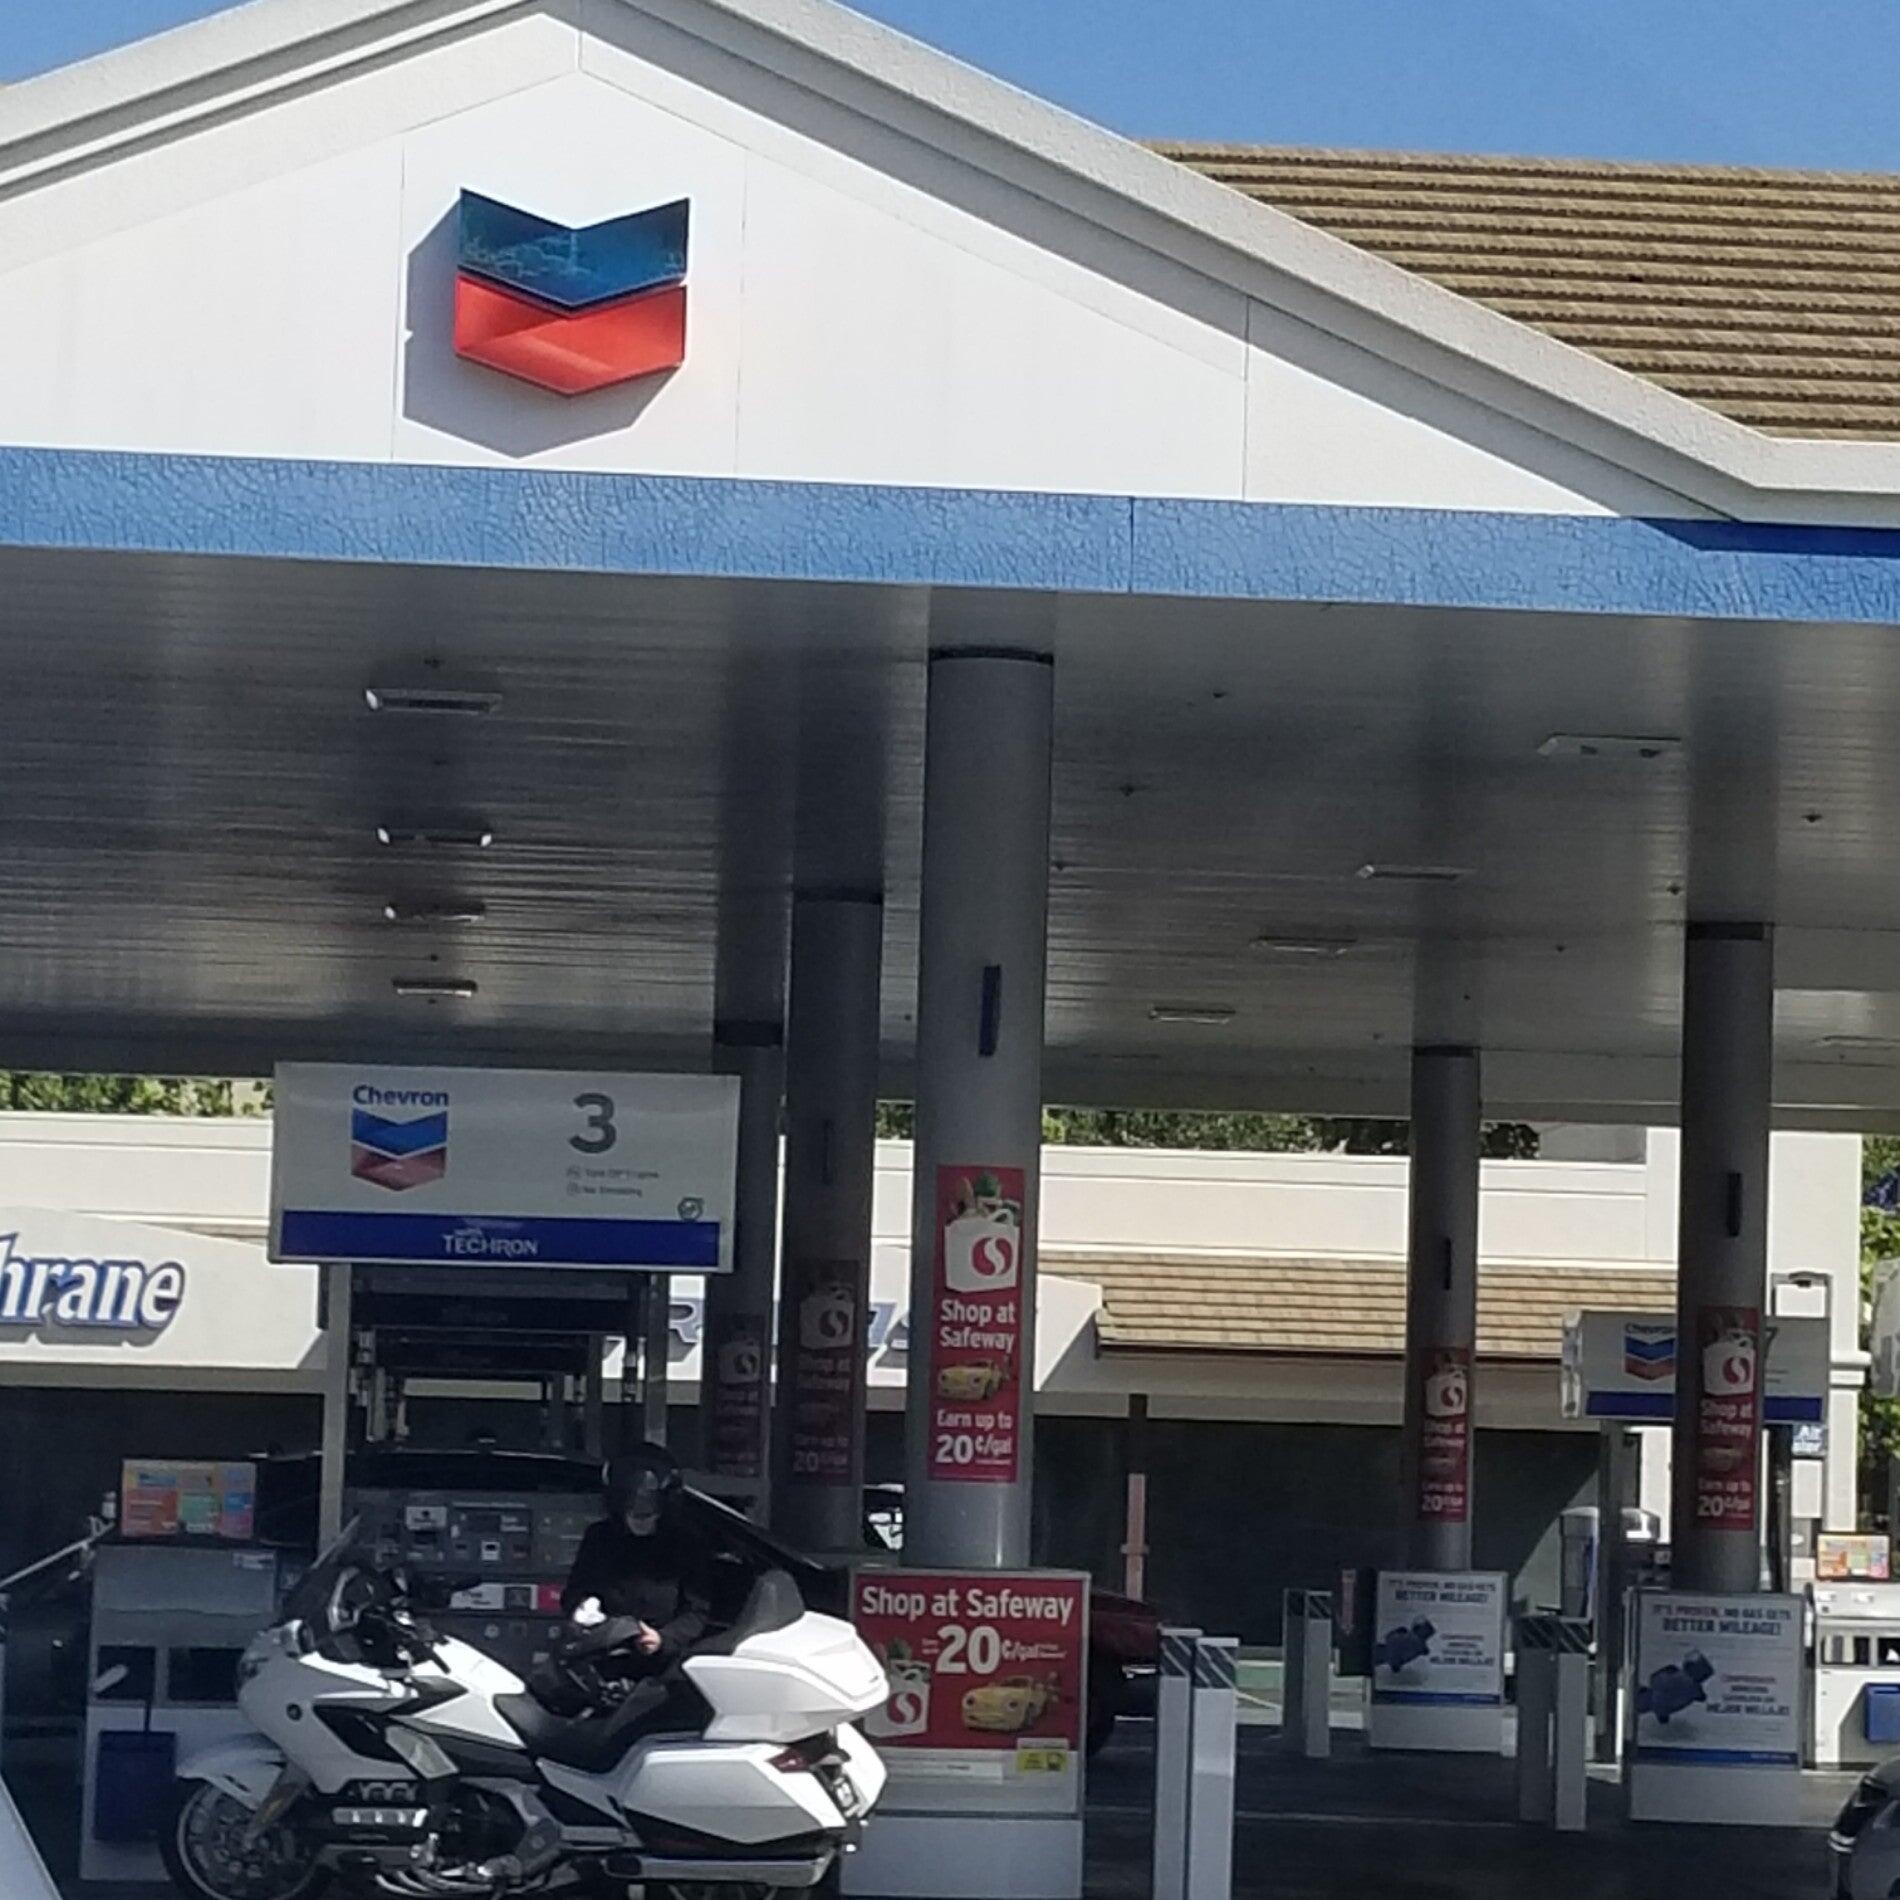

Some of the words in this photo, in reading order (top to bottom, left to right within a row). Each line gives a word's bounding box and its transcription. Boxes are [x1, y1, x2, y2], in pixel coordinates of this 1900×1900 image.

[353, 1085, 449, 1107] Chevron
[569, 1092, 617, 1154] 3
[443, 1234, 538, 1258] TECHRON
[941, 1299, 992, 1327] Shop
[996, 1302, 1016, 1324] at
[940, 1327, 1015, 1354] Safeway
[937, 1409, 972, 1428] Earn
[975, 1414, 995, 1431] up
[998, 1411, 1012, 1429] to
[935, 1434, 974, 1464] 20
[862, 1586, 925, 1622] Shop
[931, 1588, 959, 1617] at
[966, 1589, 1074, 1626] Safeway
[1663, 1617, 1714, 1632] BETTER
[936, 1624, 1000, 1675] 20
